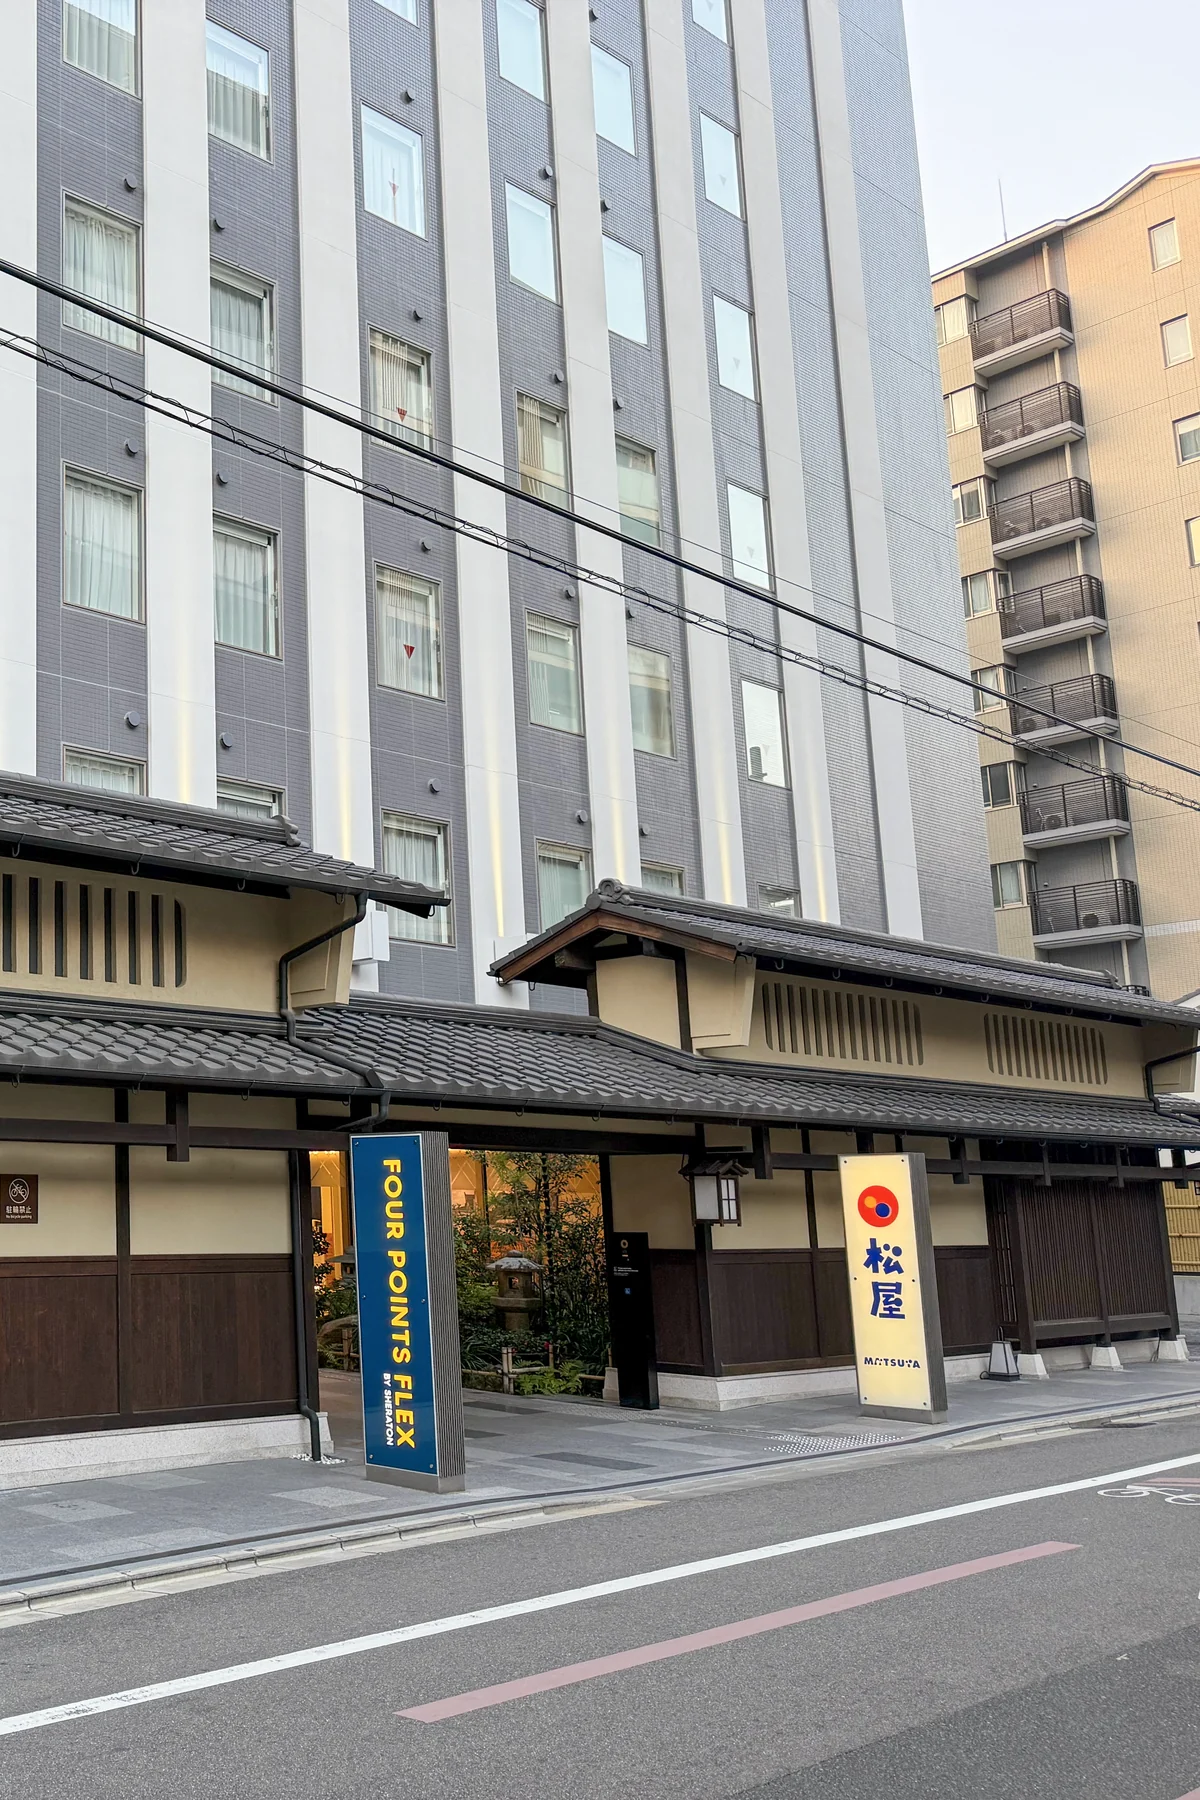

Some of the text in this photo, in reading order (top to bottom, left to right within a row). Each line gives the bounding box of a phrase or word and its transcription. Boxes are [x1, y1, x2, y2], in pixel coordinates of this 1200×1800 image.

[382, 1159, 416, 1449] FOUR POINTS FLEX
[862, 1237, 906, 1320] 松屋
[863, 1356, 921, 1369] MATSUYA
[382, 1373, 395, 1446] BY SHERATON
